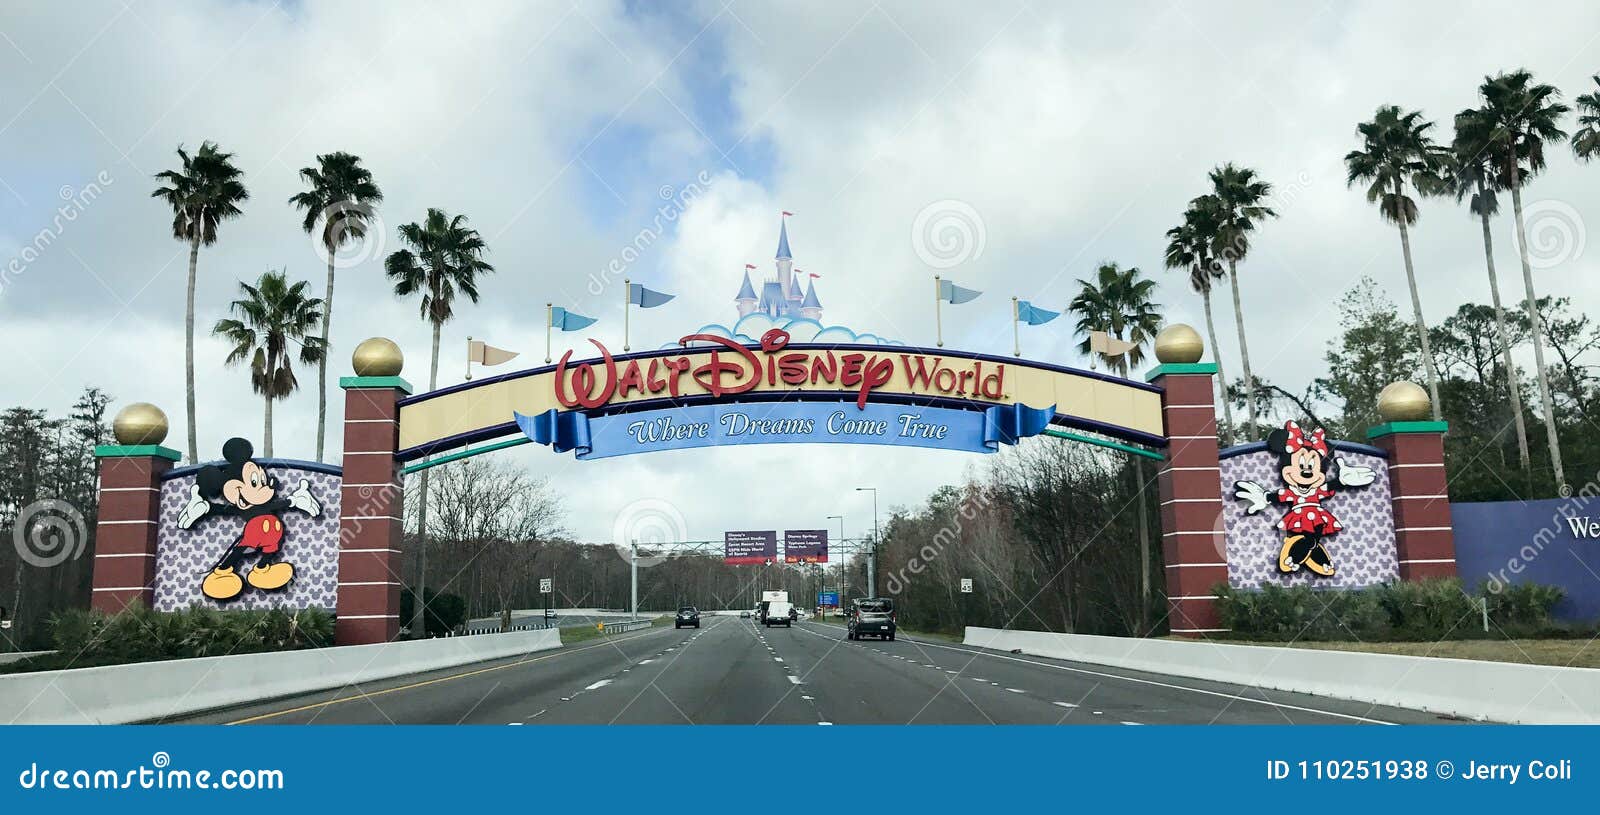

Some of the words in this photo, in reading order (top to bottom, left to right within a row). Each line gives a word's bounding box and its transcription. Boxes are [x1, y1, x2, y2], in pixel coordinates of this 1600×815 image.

[900, 354, 1004, 399] World
[628, 416, 710, 445] Where
[720, 412, 815, 437] Dreams
[827, 411, 888, 436] Come
[898, 413, 948, 440] True
